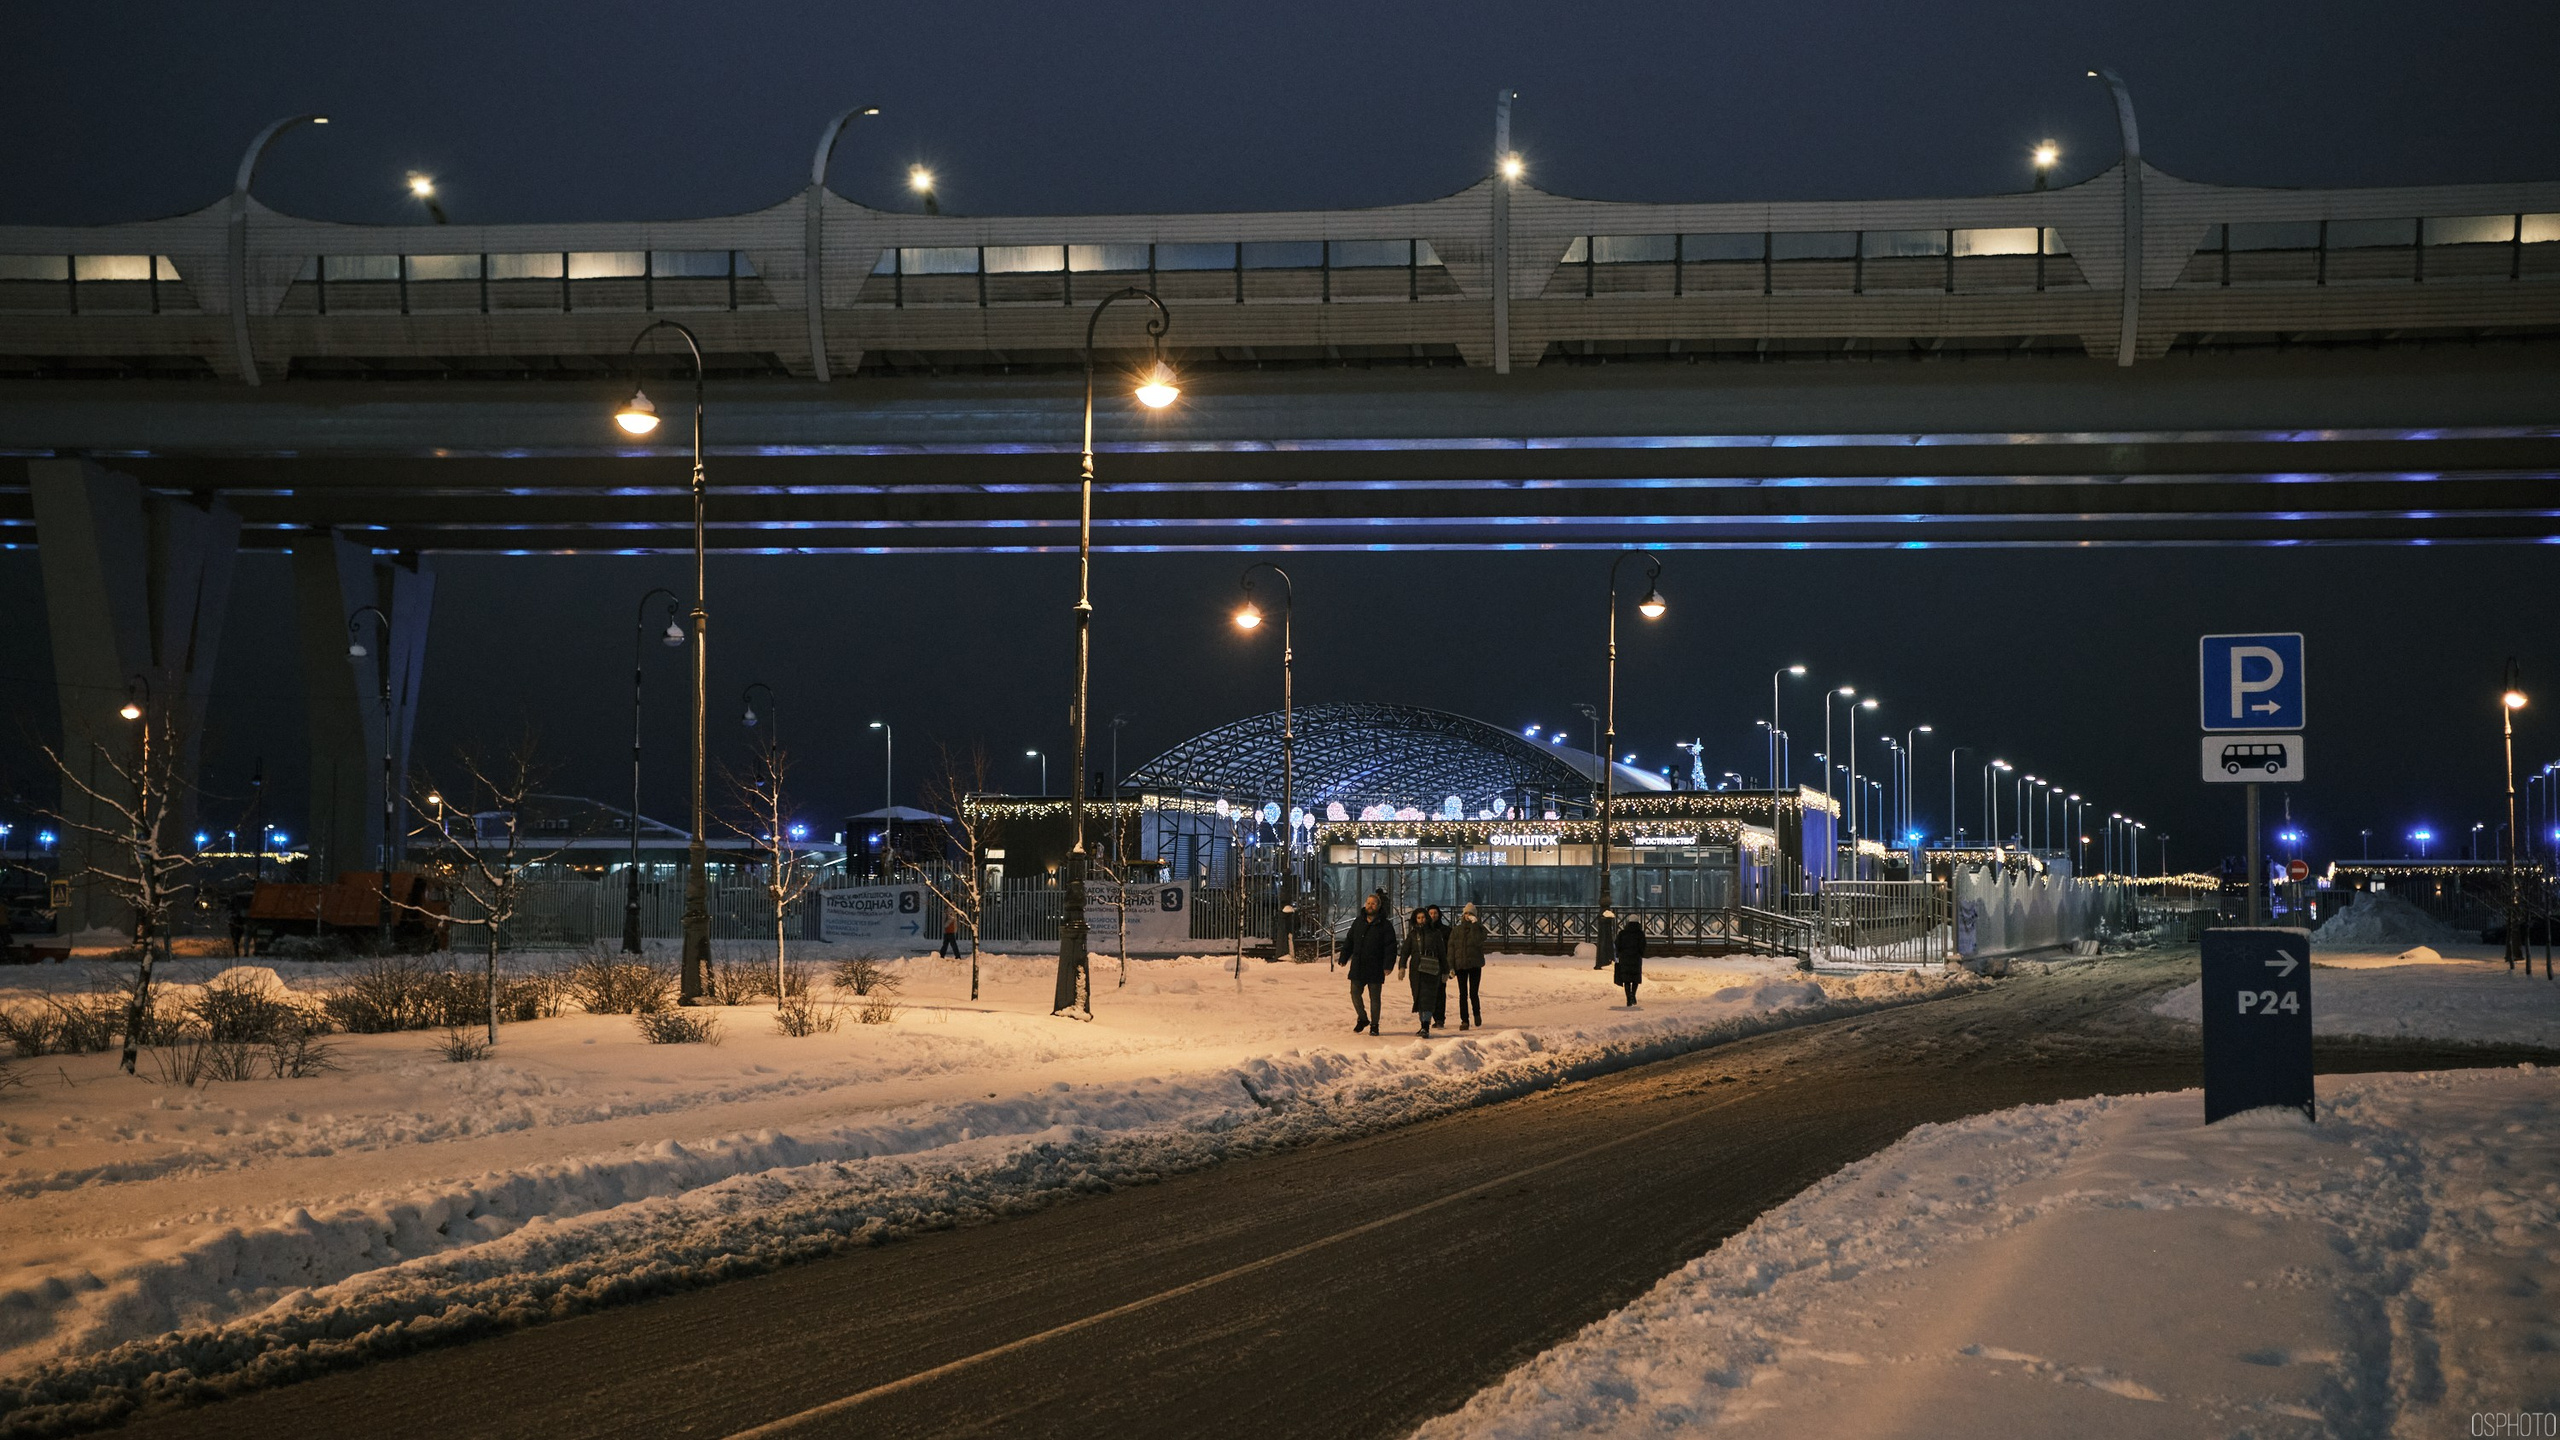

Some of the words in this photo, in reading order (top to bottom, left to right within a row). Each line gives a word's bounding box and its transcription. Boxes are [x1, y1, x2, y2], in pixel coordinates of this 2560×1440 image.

[2231, 646, 2284, 718] P
[1358, 838, 1418, 846] ОБЩЕСТВЕННОЕ
[1490, 834, 1558, 846] ФЛАГШТОК
[827, 898, 894, 911] ПРОХОДНАЯ
[904, 894, 915, 910] 3
[1167, 891, 1177, 908] 3
[2238, 990, 2300, 1014] P24
